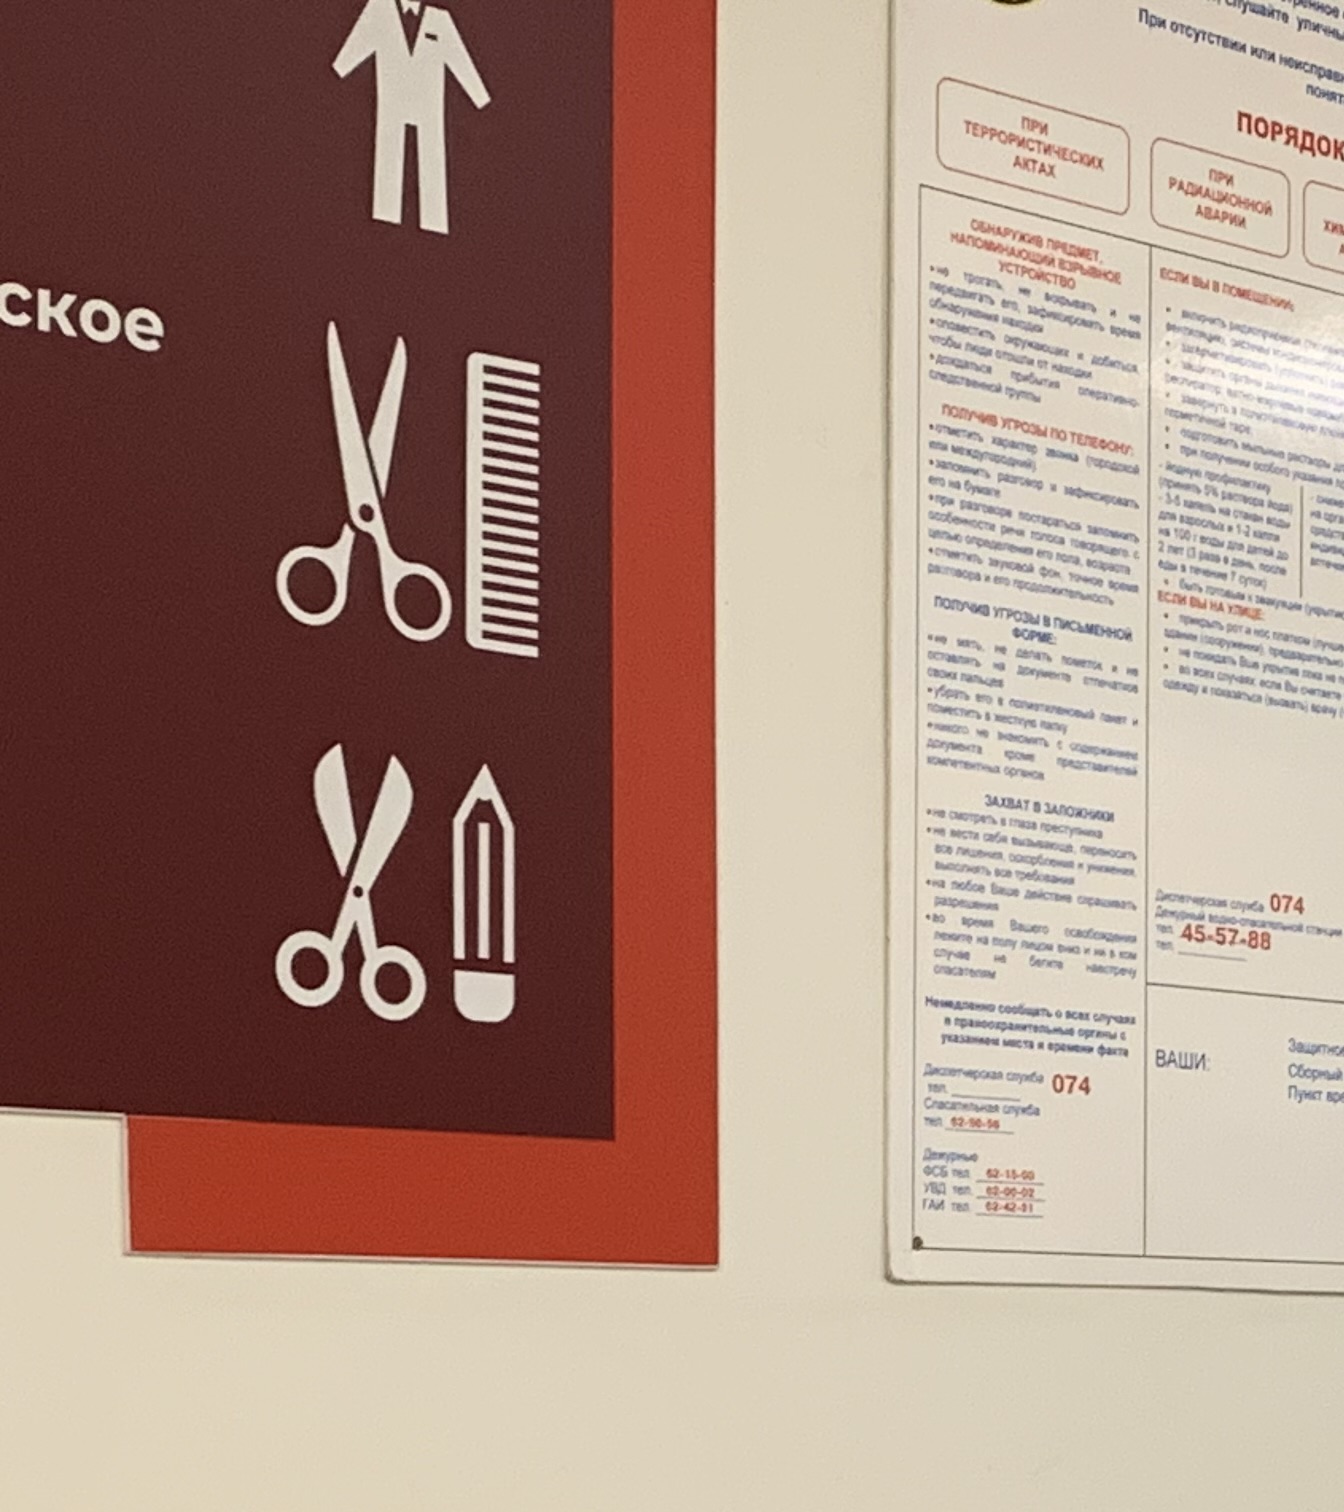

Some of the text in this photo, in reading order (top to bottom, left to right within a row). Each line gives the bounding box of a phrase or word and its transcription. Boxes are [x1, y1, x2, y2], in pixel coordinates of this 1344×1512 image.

[1020, 115, 1049, 136] ПРИ
[964, 119, 1104, 171] ТЕРРОРИСТИЧЕСКИХ
[1012, 154, 1056, 179] АКТАХ
[1208, 167, 1234, 187] ПРИ
[1168, 176, 1273, 216] РАДИАЦИОННОЙ
[1194, 203, 1246, 229] АВАРИИ
[1269, 892, 1305, 915] 074
[1179, 923, 1271, 951] 45-57-88
[1051, 1073, 1091, 1096] 074
